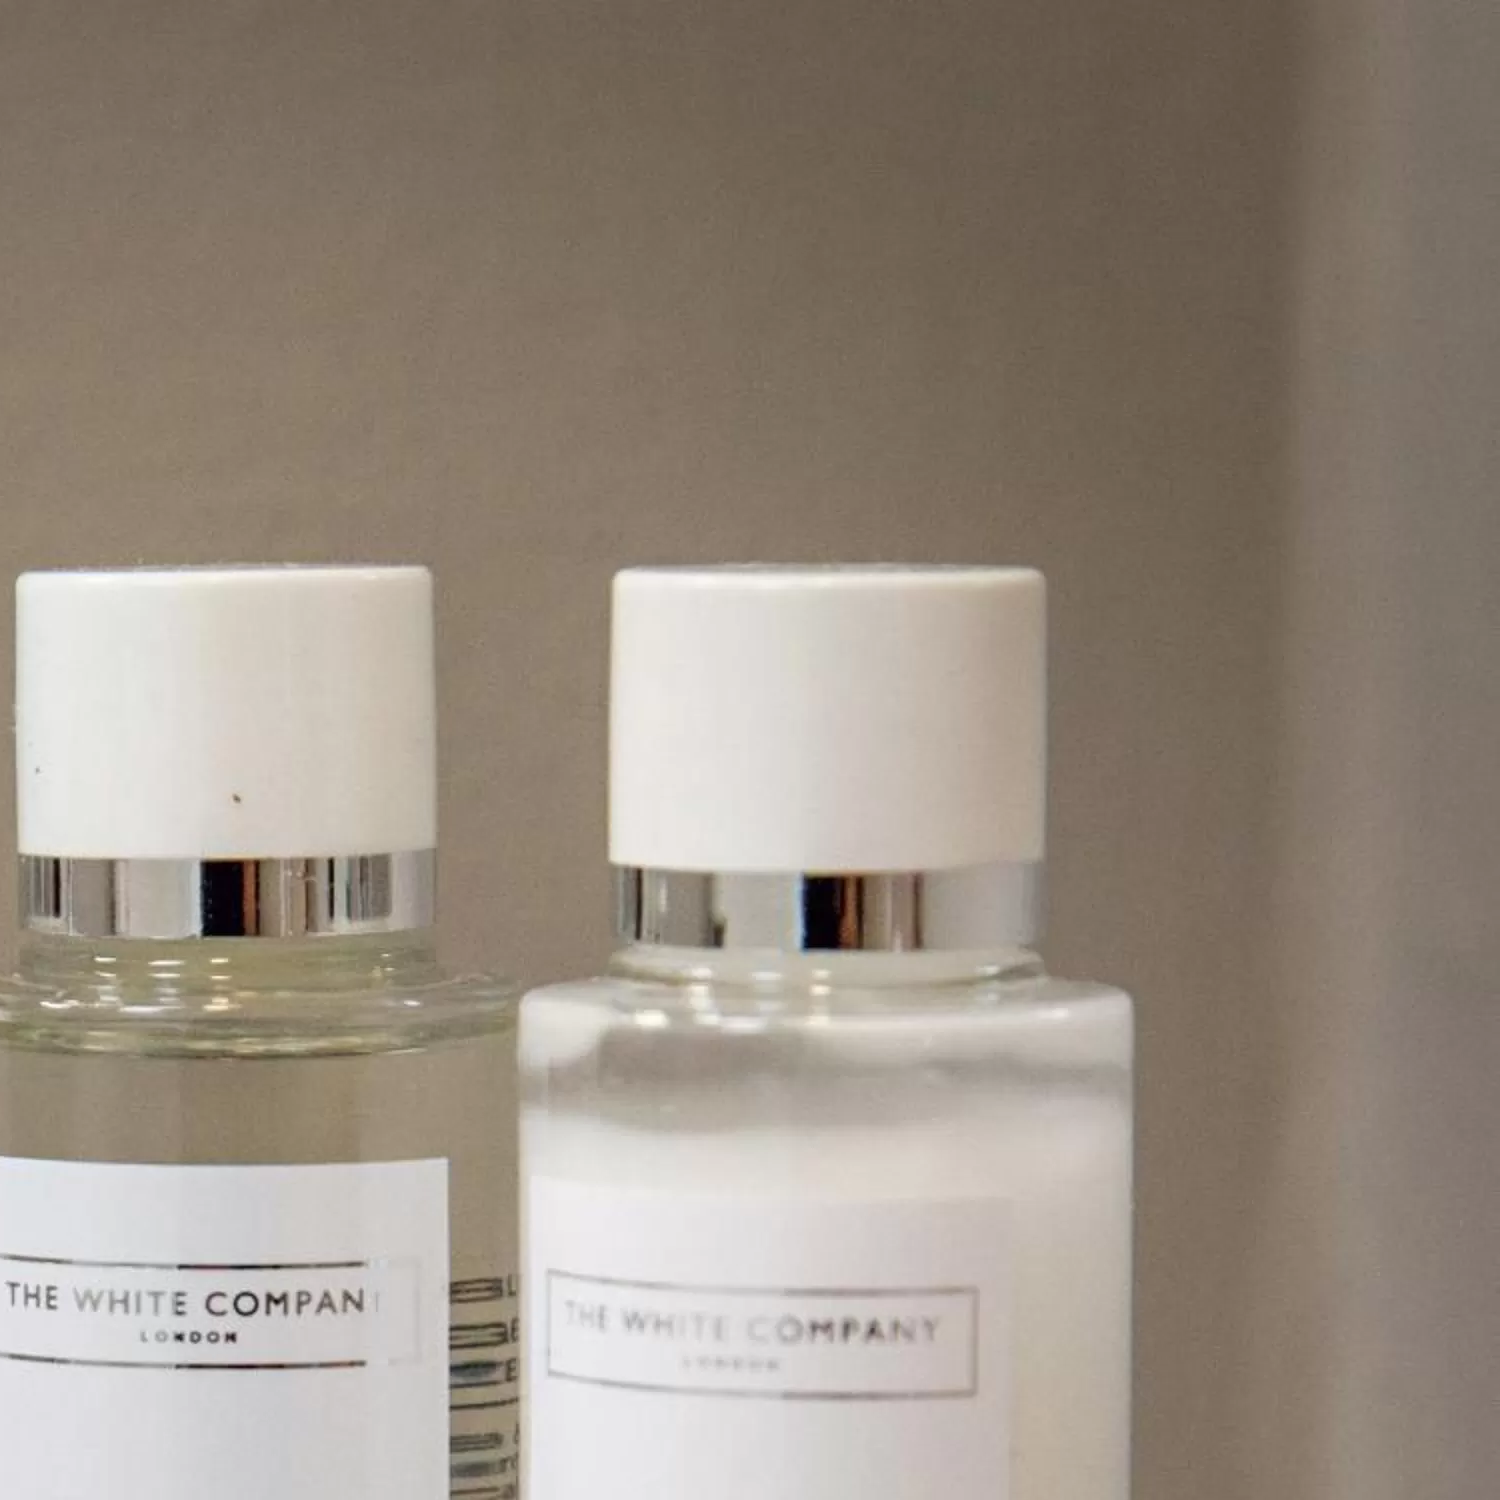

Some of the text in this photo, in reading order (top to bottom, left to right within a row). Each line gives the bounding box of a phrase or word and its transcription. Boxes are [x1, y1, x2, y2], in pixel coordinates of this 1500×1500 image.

[6, 1281, 380, 1318] THE WHITE COMPAN
[139, 1330, 238, 1344] LONDON
[565, 1300, 941, 1346] THE WHITE COMPANY
